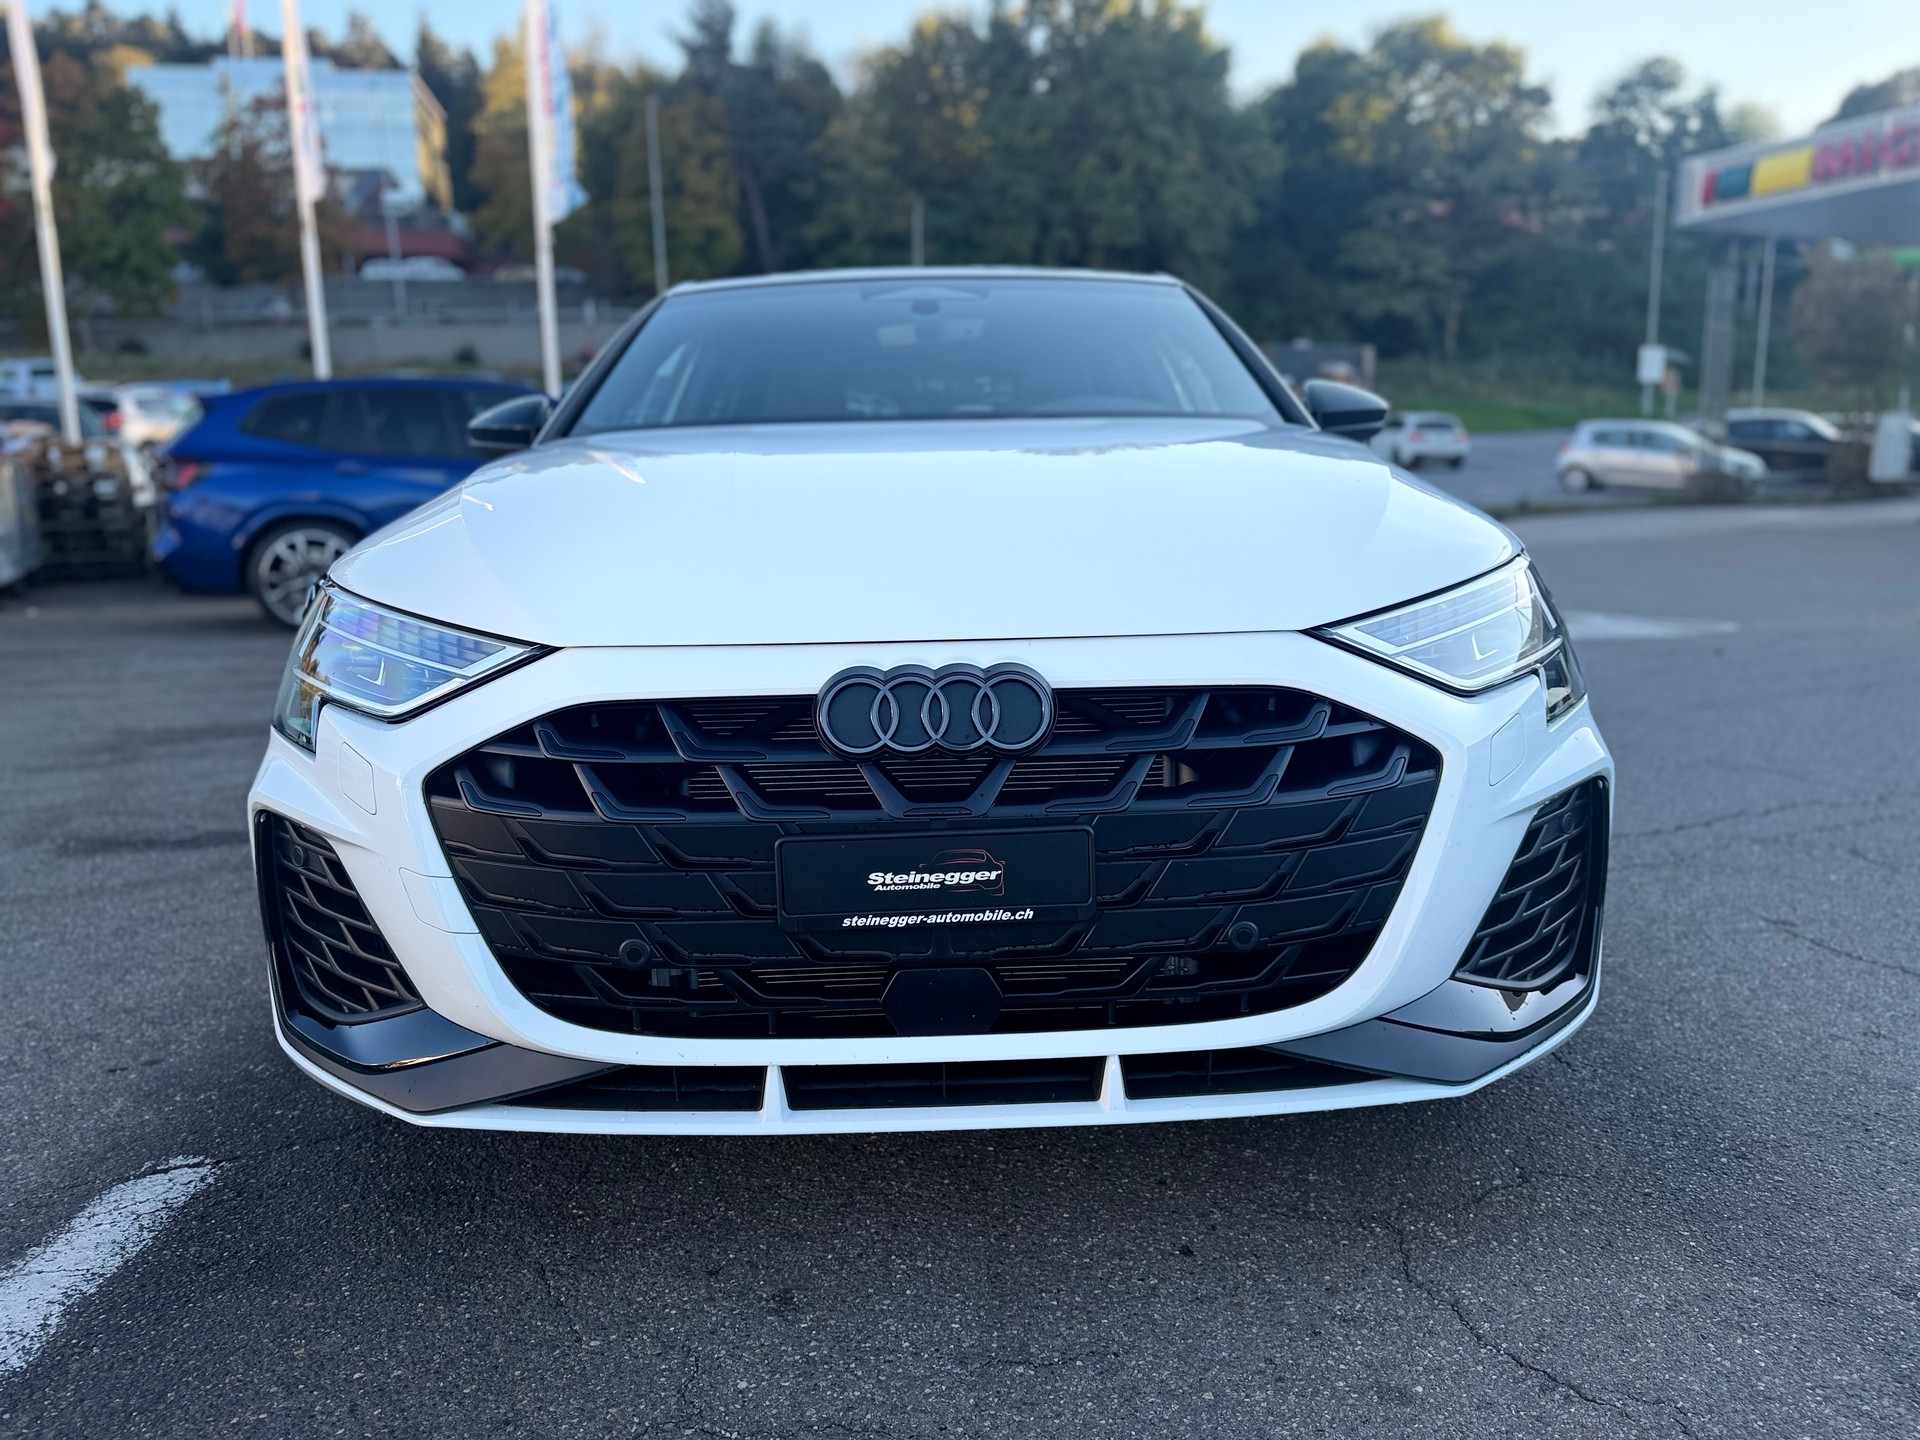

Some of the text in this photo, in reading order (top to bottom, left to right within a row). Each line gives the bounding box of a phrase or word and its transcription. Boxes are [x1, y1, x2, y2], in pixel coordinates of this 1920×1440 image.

[1813, 124, 1920, 180] MIG
[867, 869, 1002, 885] Steinegger
[873, 882, 941, 892] Automobile
[842, 908, 1034, 928] steinegger-automobile.ch
